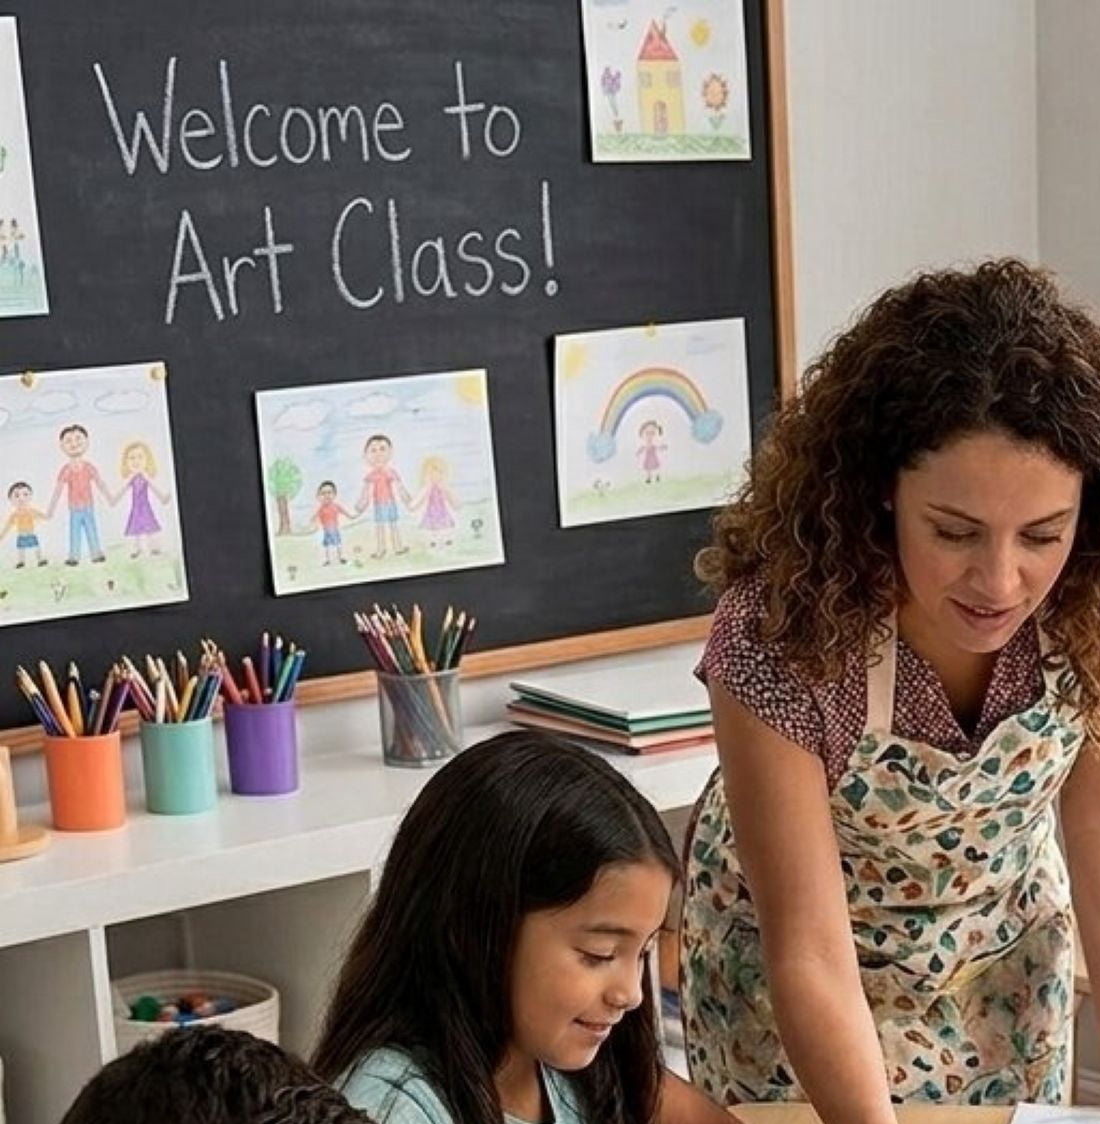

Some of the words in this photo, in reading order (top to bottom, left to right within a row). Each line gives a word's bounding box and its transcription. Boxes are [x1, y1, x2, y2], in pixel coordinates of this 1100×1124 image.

[93, 56, 412, 175] Welcome
[443, 60, 521, 159] to
[164, 205, 294, 325] Art
[331, 180, 559, 309] Class!
